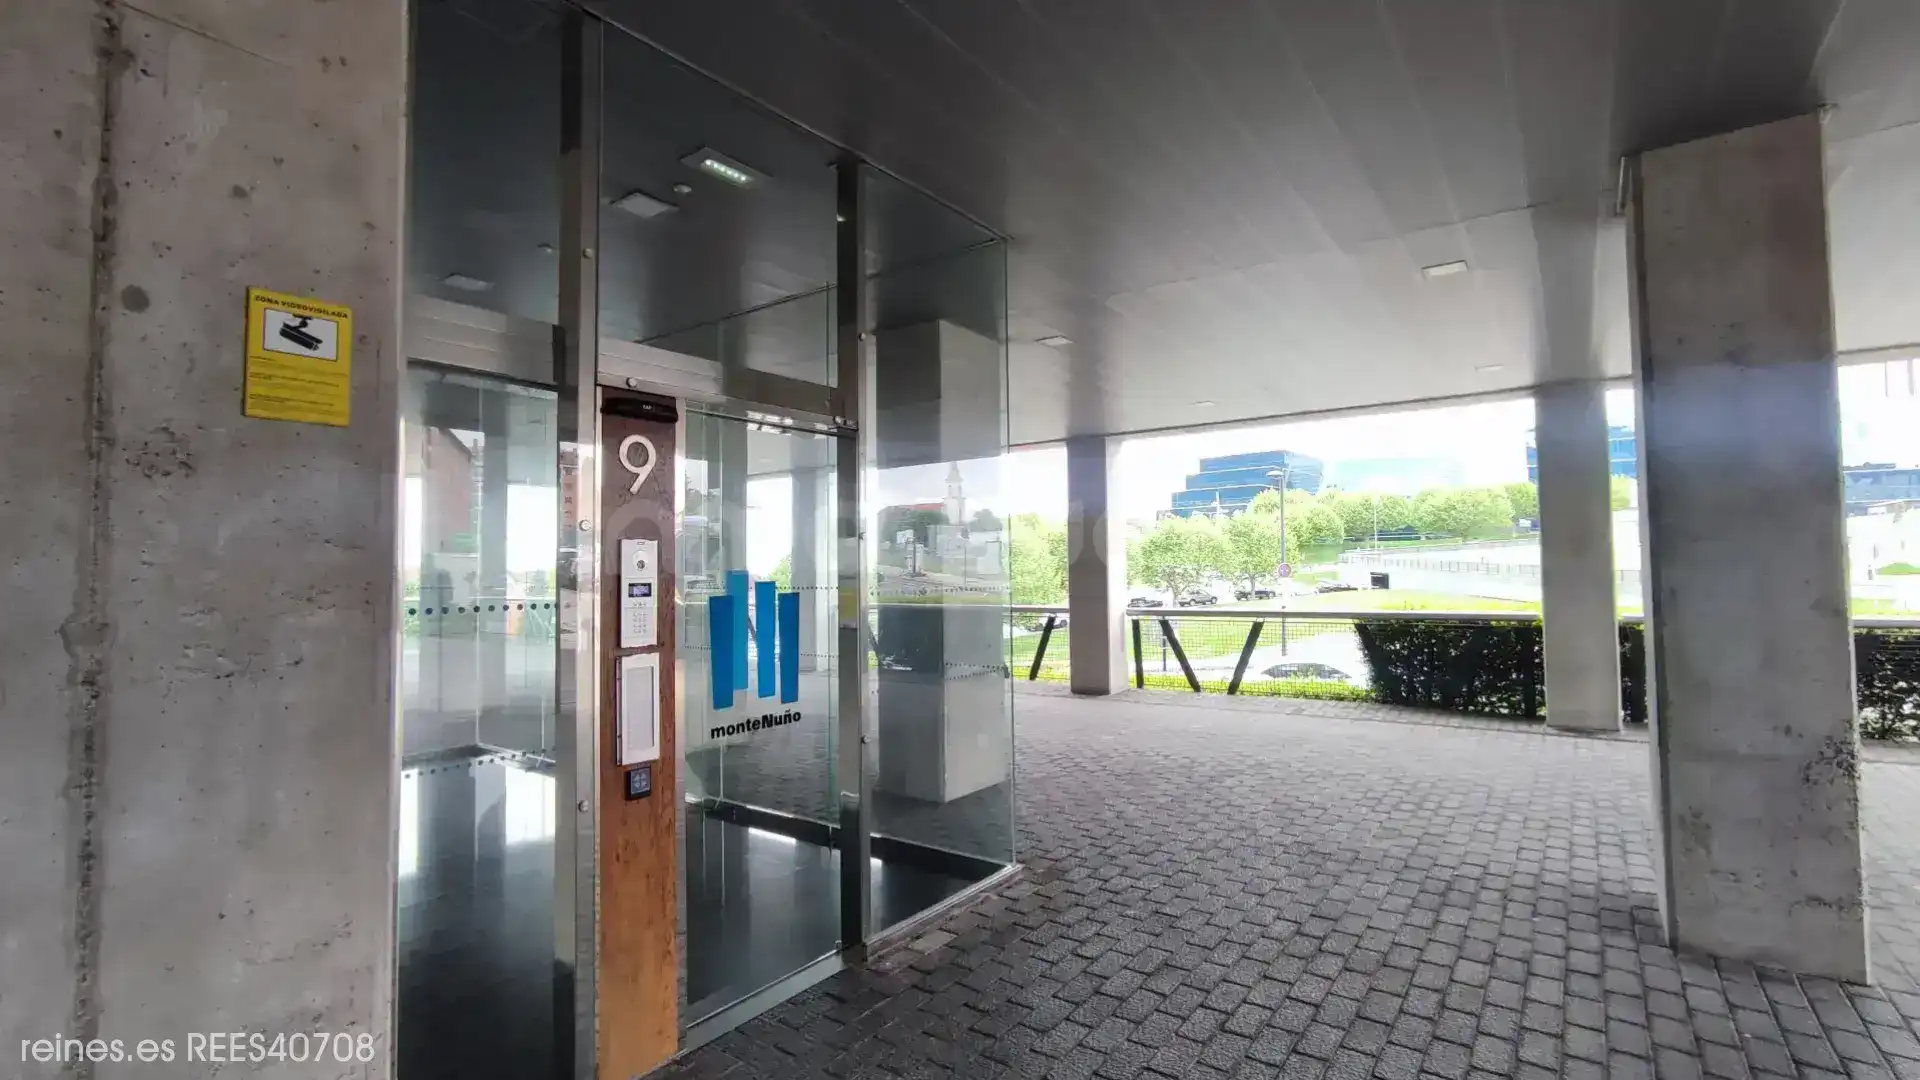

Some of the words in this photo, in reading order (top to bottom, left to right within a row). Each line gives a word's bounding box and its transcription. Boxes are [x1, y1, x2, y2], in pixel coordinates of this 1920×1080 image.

[255, 295, 279, 305] ZONA
[619, 434, 657, 495] 9
[710, 708, 802, 740] monteNuño
